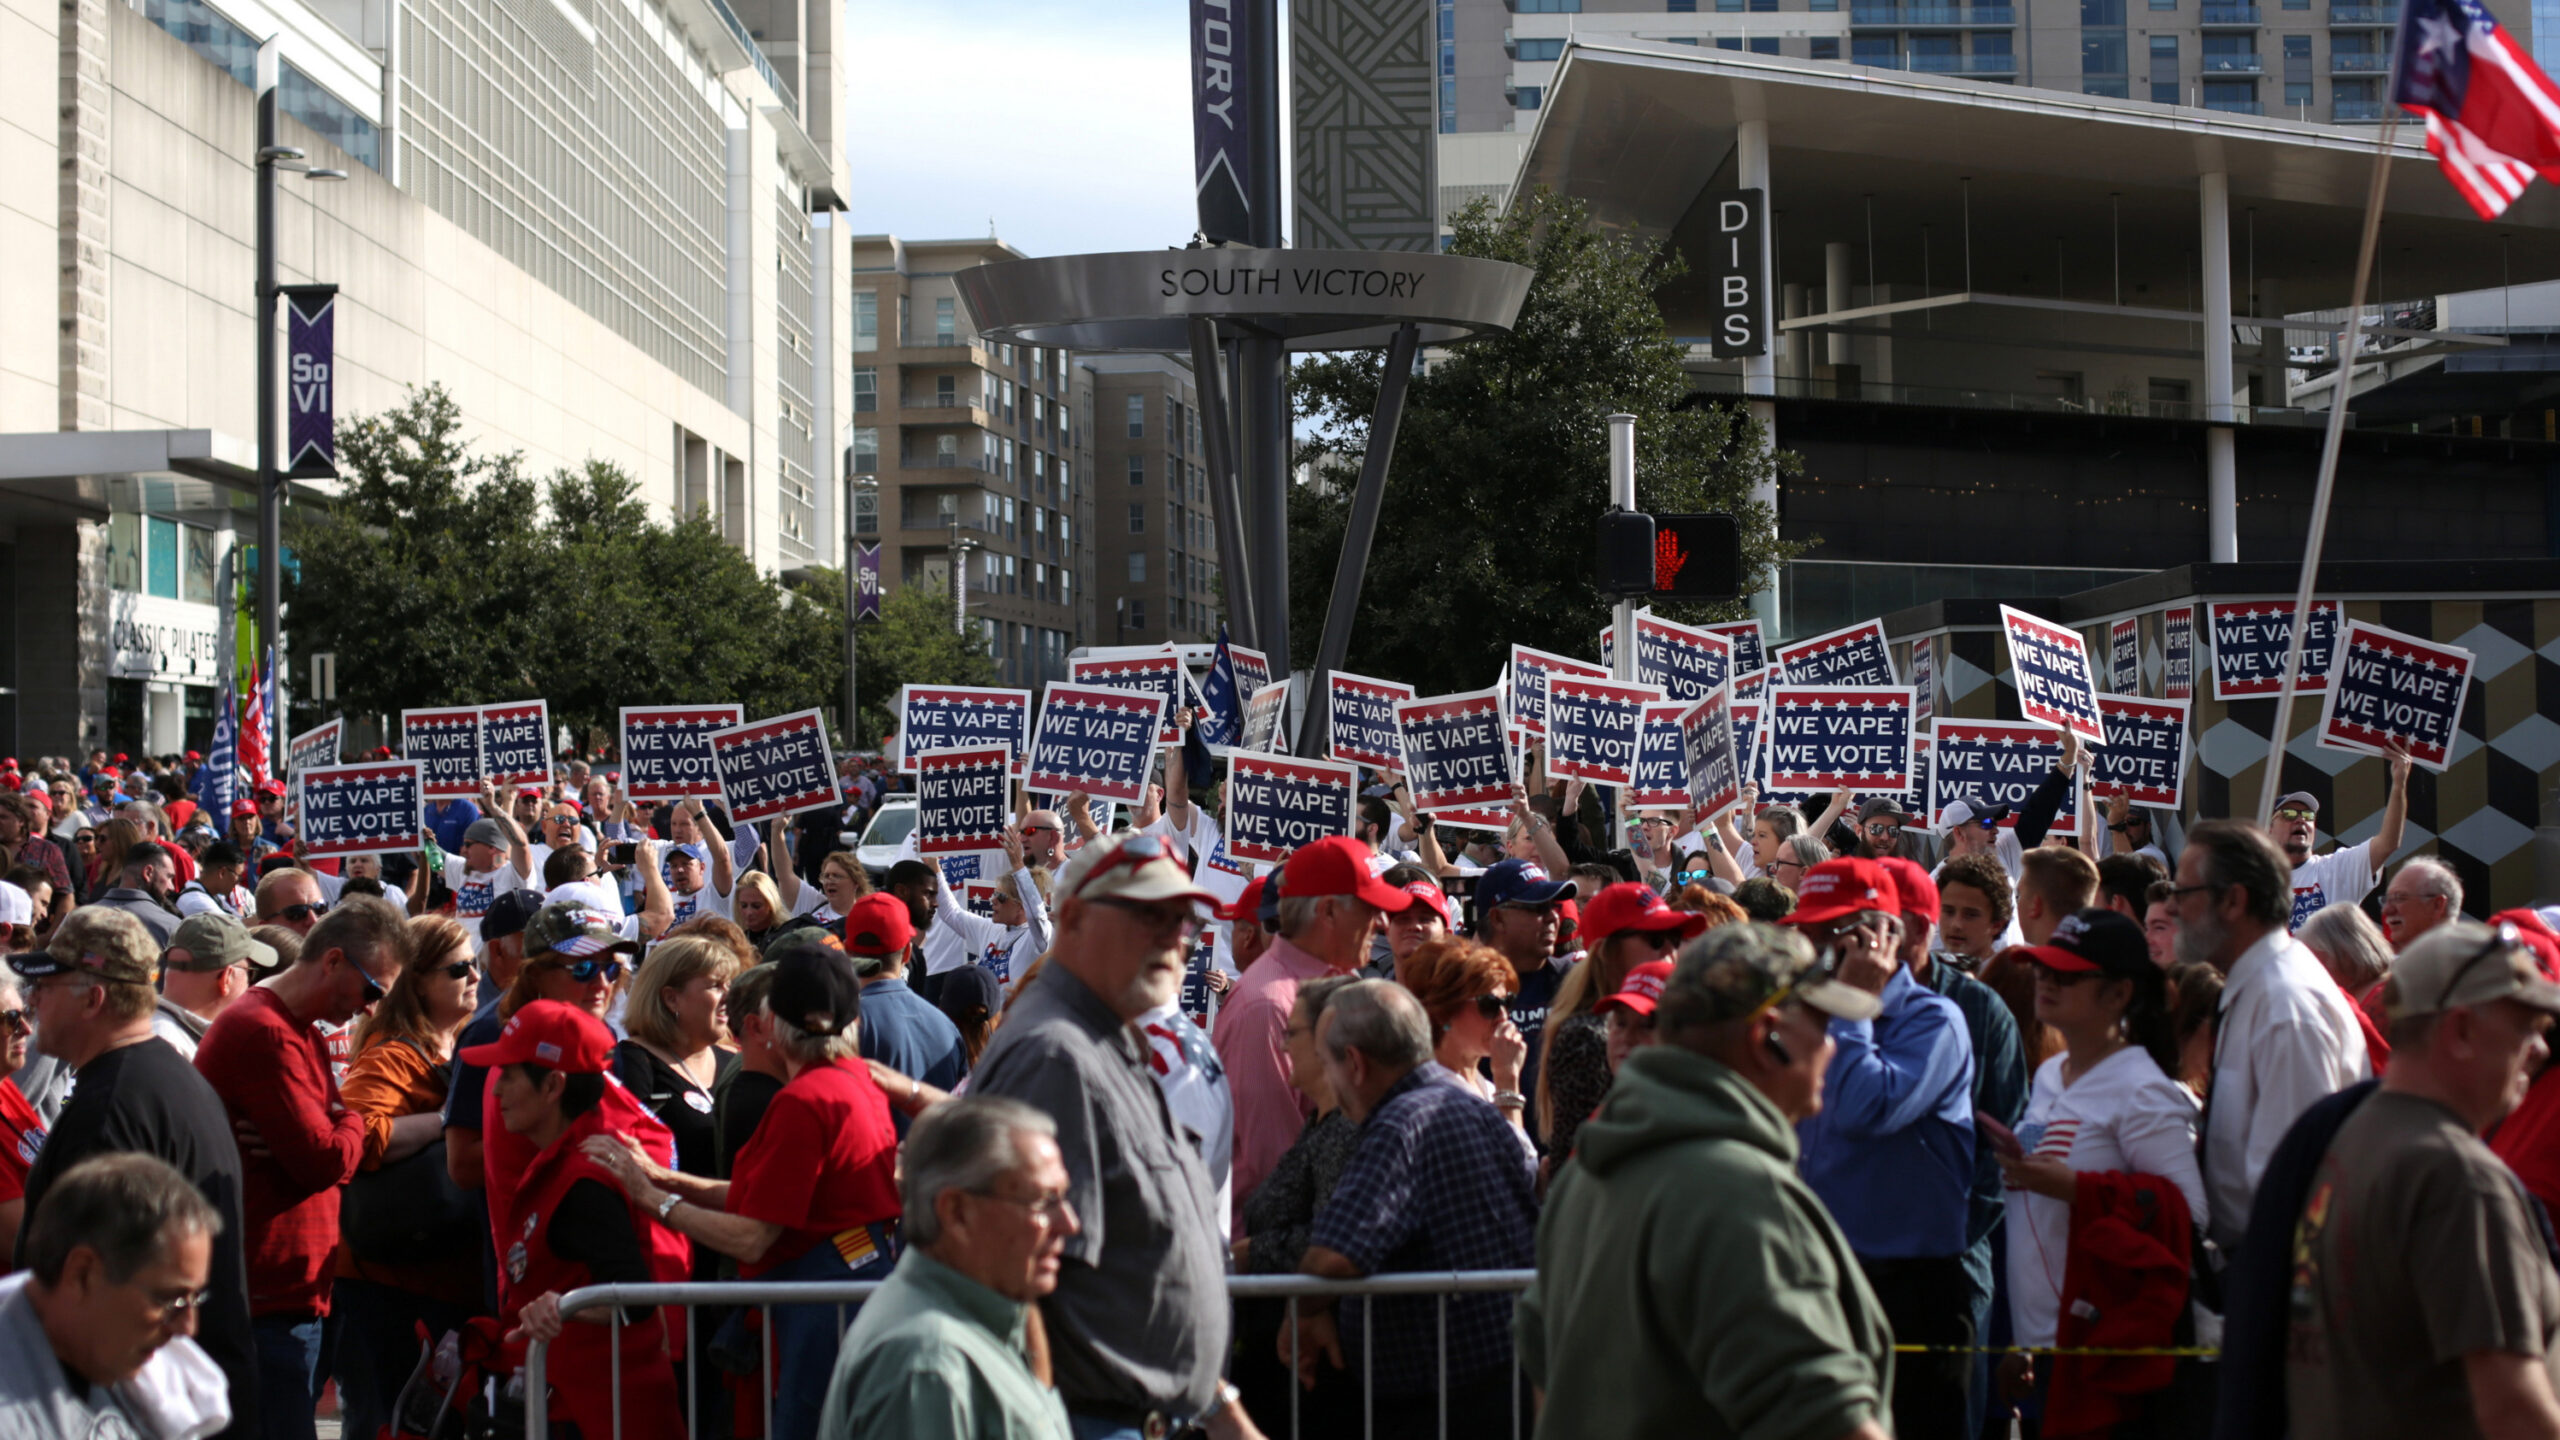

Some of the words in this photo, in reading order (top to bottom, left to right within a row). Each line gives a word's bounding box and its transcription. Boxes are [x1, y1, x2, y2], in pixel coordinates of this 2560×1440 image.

[1160, 268, 1280, 297] SOUTH
[1293, 267, 1426, 299] VICTORY
[1719, 200, 1752, 347] DIBS
[292, 352, 328, 383] So
[292, 384, 327, 413] VI
[860, 567, 877, 581] So
[860, 581, 876, 595] VI
[113, 619, 165, 656] CLASSIC
[172, 628, 218, 661] PILATES
[2217, 627, 2258, 644] WE
[1638, 640, 1668, 664] WE
[2012, 639, 2040, 667] WE
[2220, 654, 2259, 672] WE
[2347, 656, 2384, 682] WE
[1516, 670, 1544, 690] WE
[1788, 666, 1821, 684] WE
[2018, 670, 2046, 696] WE
[1333, 698, 1359, 717] WE
[1361, 703, 1392, 722] VAP
[1516, 694, 1544, 713] WE
[2339, 687, 2378, 716] WE
[909, 709, 946, 726] WE
[1045, 714, 1079, 735] WE
[1552, 704, 1586, 724] WE
[1590, 709, 1639, 731] VAP
[1776, 716, 1819, 735] WE
[907, 733, 945, 749] WE
[1334, 722, 1359, 740] WE
[407, 734, 430, 751] WE
[628, 734, 664, 751] WE
[668, 732, 710, 750] VAP
[1404, 732, 1434, 752] WE
[1552, 732, 1586, 753] WE
[1591, 737, 1634, 757] VOT
[1643, 733, 1679, 751] WE
[290, 755, 306, 770] WE
[720, 752, 758, 775] WE
[1038, 743, 1072, 764] WE
[1686, 742, 1702, 766] WE
[1775, 745, 1818, 764] WE
[1939, 750, 1984, 771] WE
[628, 758, 664, 775] WE
[669, 757, 716, 774] VOT
[1410, 762, 1441, 782] WE
[1639, 761, 1672, 779] WE
[726, 778, 761, 800] WE
[921, 780, 947, 799] WE
[1692, 769, 1707, 794] WE
[1939, 781, 1982, 802] WE
[306, 792, 342, 809] WE
[1235, 783, 1271, 805] WE
[307, 817, 343, 834] WE
[921, 809, 948, 827] WE
[1234, 812, 1269, 834] WE
